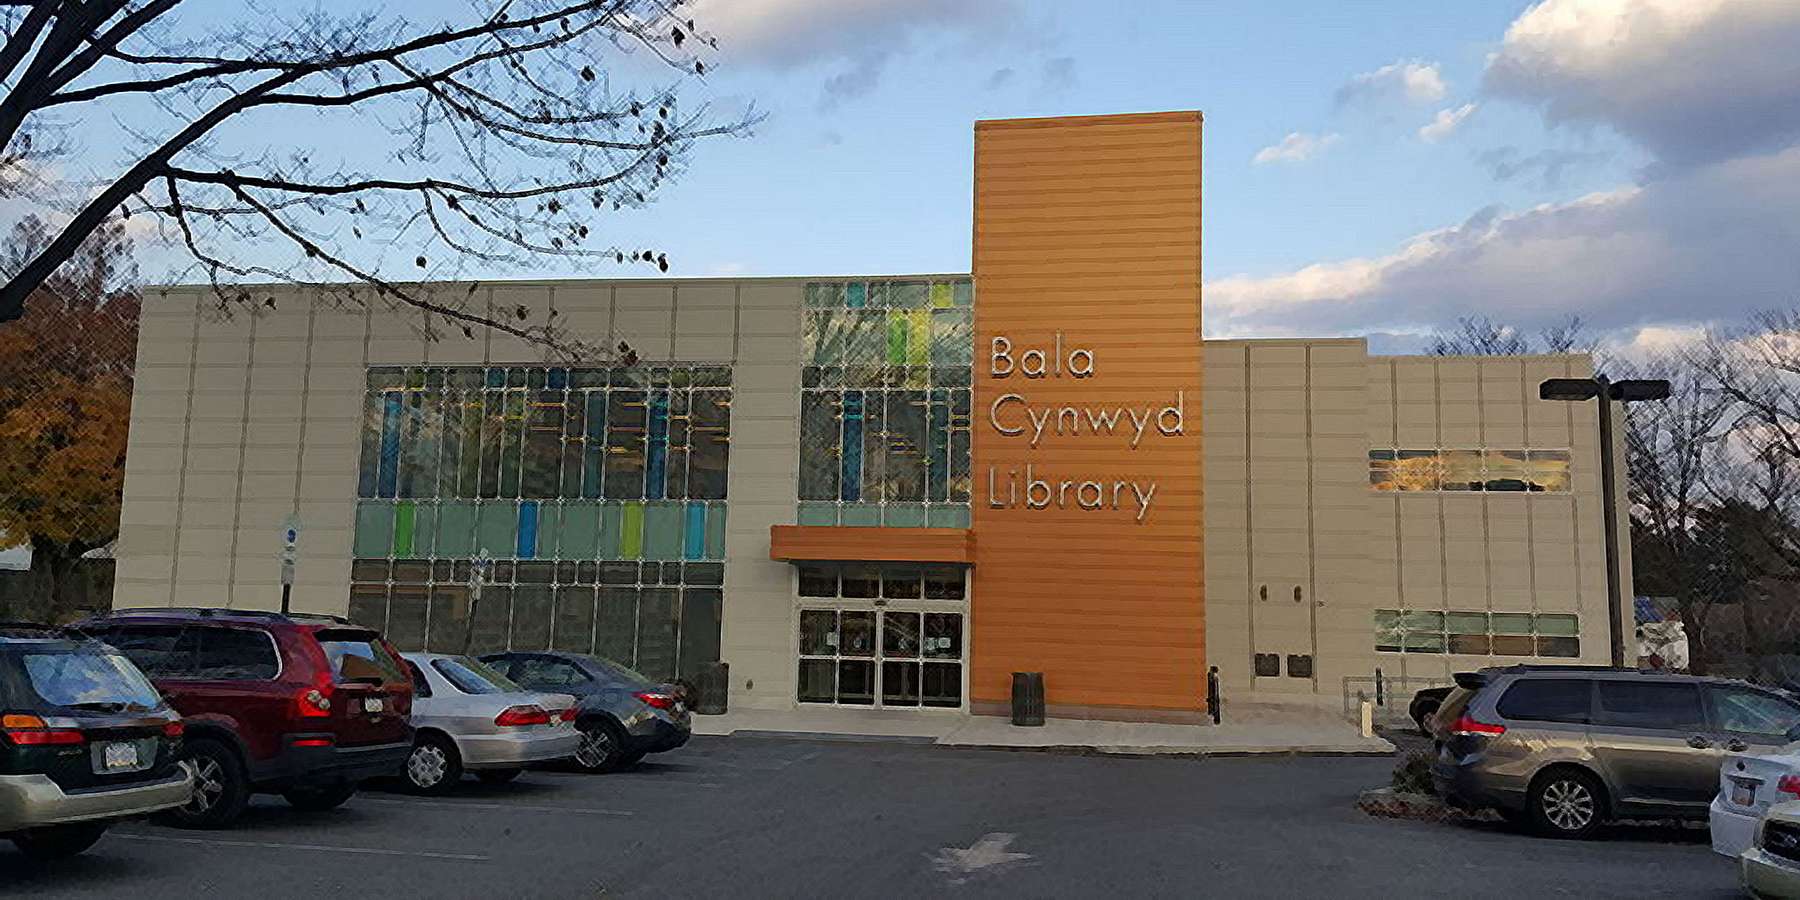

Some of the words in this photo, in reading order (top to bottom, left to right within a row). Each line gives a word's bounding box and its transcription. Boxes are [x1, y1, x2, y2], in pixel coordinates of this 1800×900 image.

[991, 329, 1095, 378] Bala
[991, 390, 1184, 449] Cynwyd
[989, 463, 1156, 522] Library
